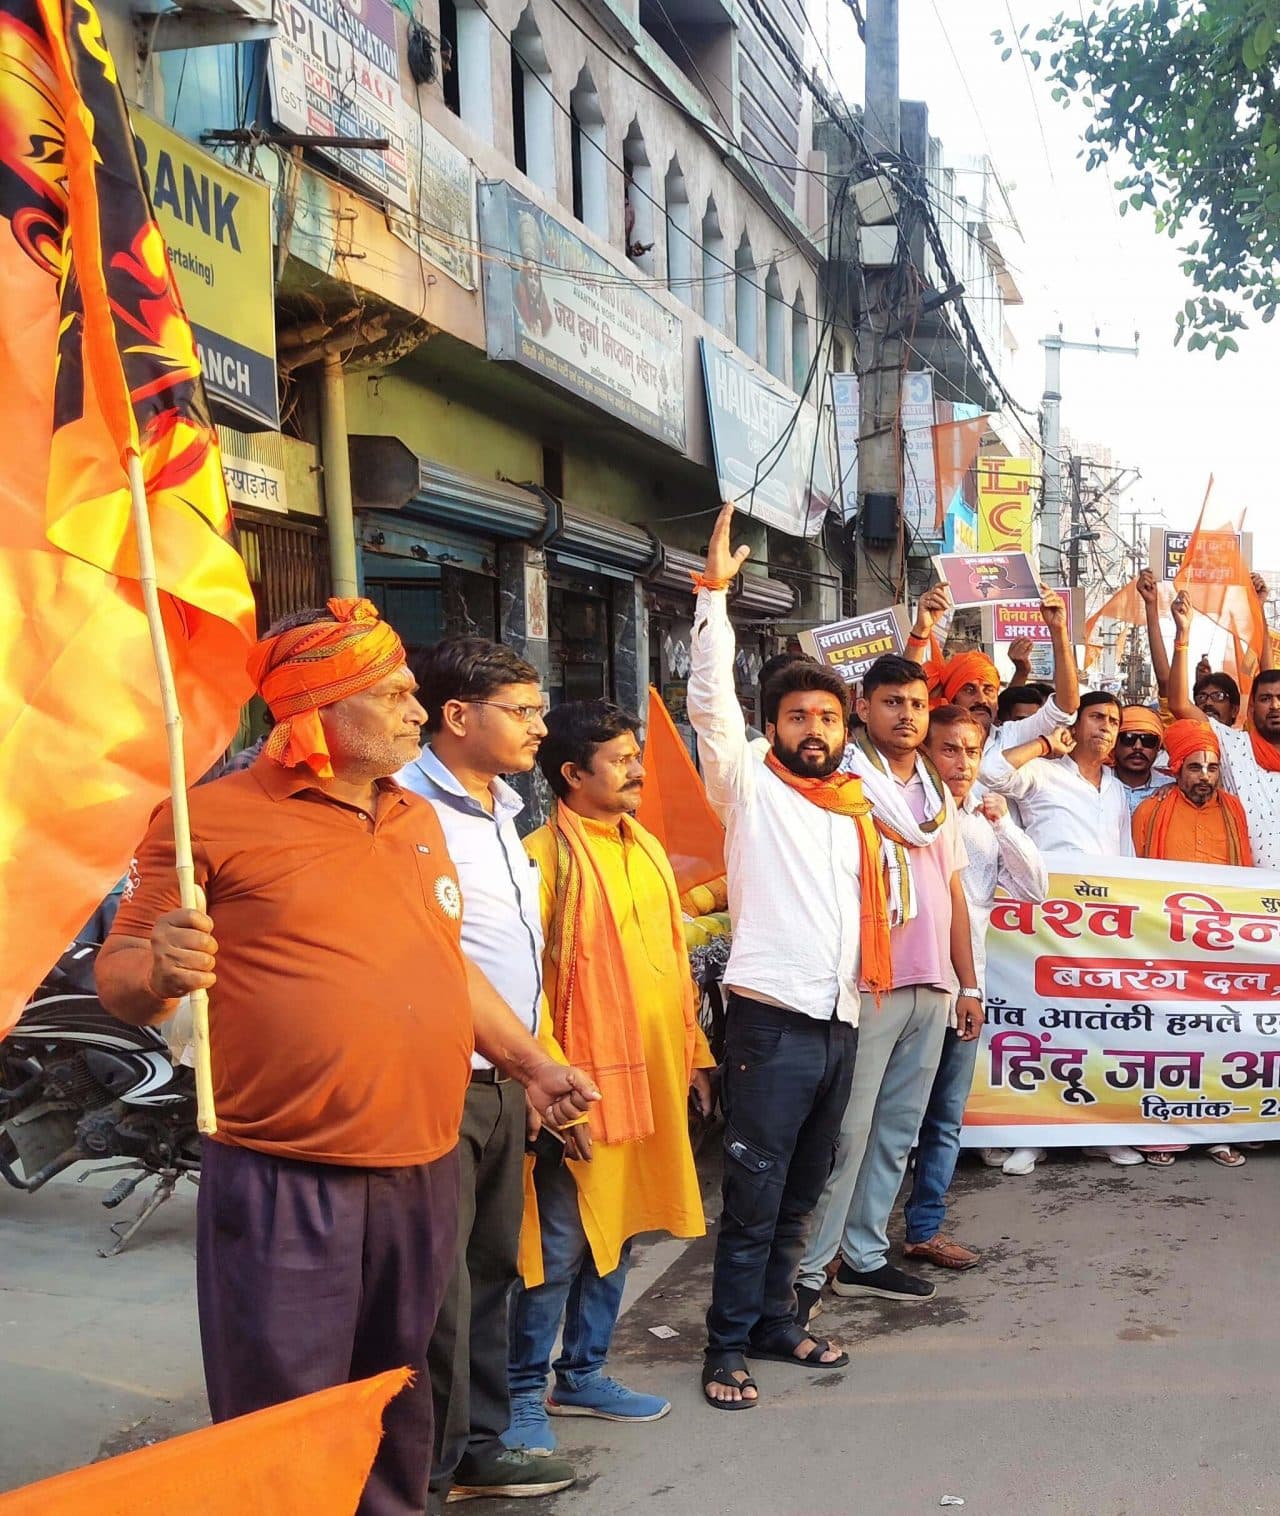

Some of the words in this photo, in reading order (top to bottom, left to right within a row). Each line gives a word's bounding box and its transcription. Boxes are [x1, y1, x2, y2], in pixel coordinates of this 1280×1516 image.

[167, 246, 215, 288] ertaking)
[198, 344, 251, 397] ANCH
[819, 627, 862, 648] सनातन
[861, 619, 894, 637] हिन्दू
[1004, 625, 1037, 637] अमर
[826, 636, 893, 664] एकता
[1074, 880, 1109, 898] सेवा
[989, 896, 1140, 940] वश्व
[1050, 960, 1189, 991] बजरंग
[1038, 1003, 1155, 1032] आतंकी
[1165, 1004, 1243, 1035] हमले
[988, 1030, 1097, 1103] हिंदू
[1102, 1048, 1205, 1091] जन
